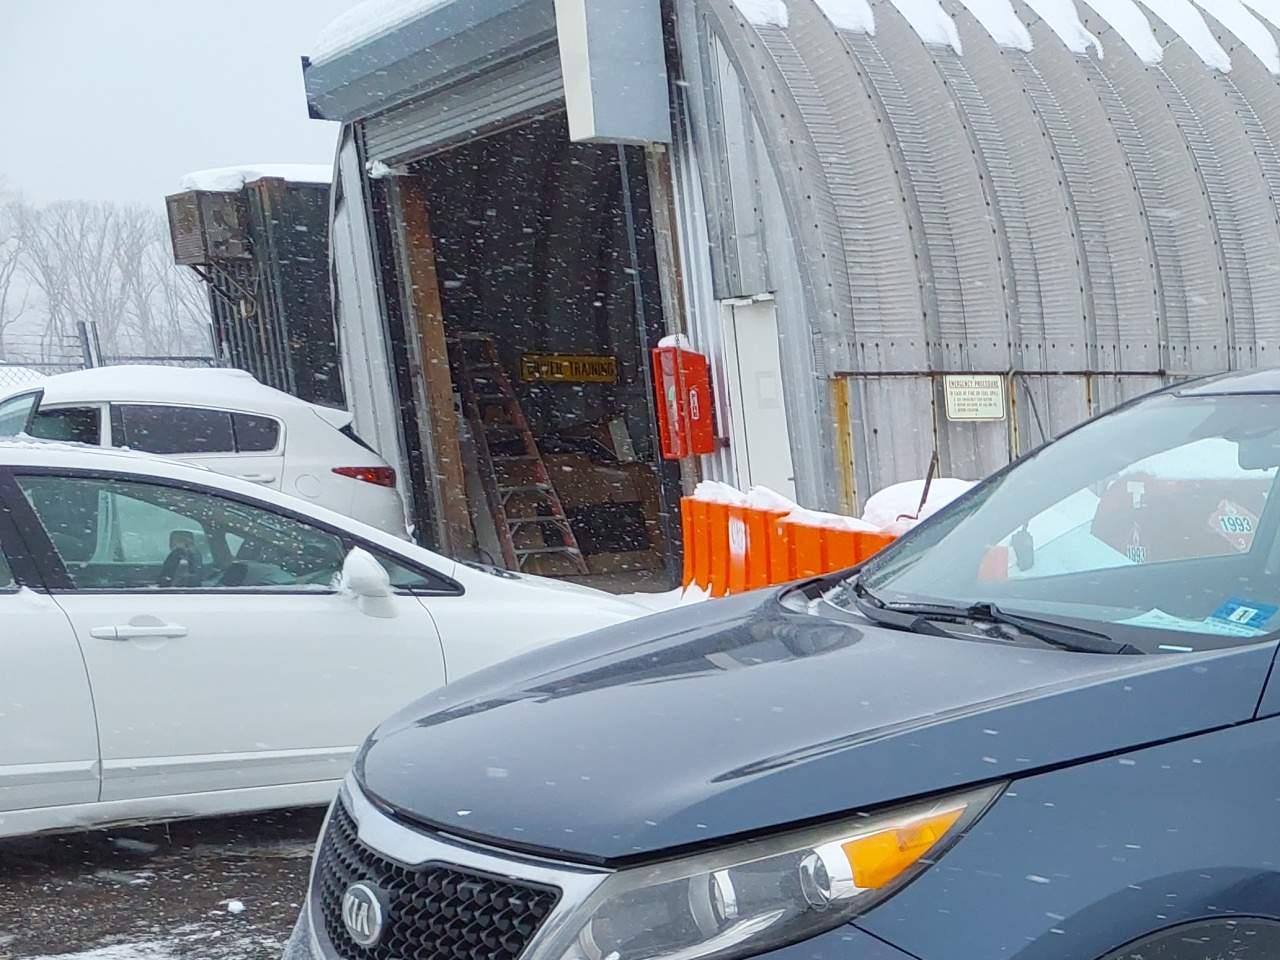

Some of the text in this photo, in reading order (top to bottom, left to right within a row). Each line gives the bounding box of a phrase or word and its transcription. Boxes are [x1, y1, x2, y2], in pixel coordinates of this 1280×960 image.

[570, 361, 615, 377] TRAINING
[1221, 516, 1252, 532] 1993
[1127, 546, 1145, 563] 1993
[343, 892, 370, 936] KIA
